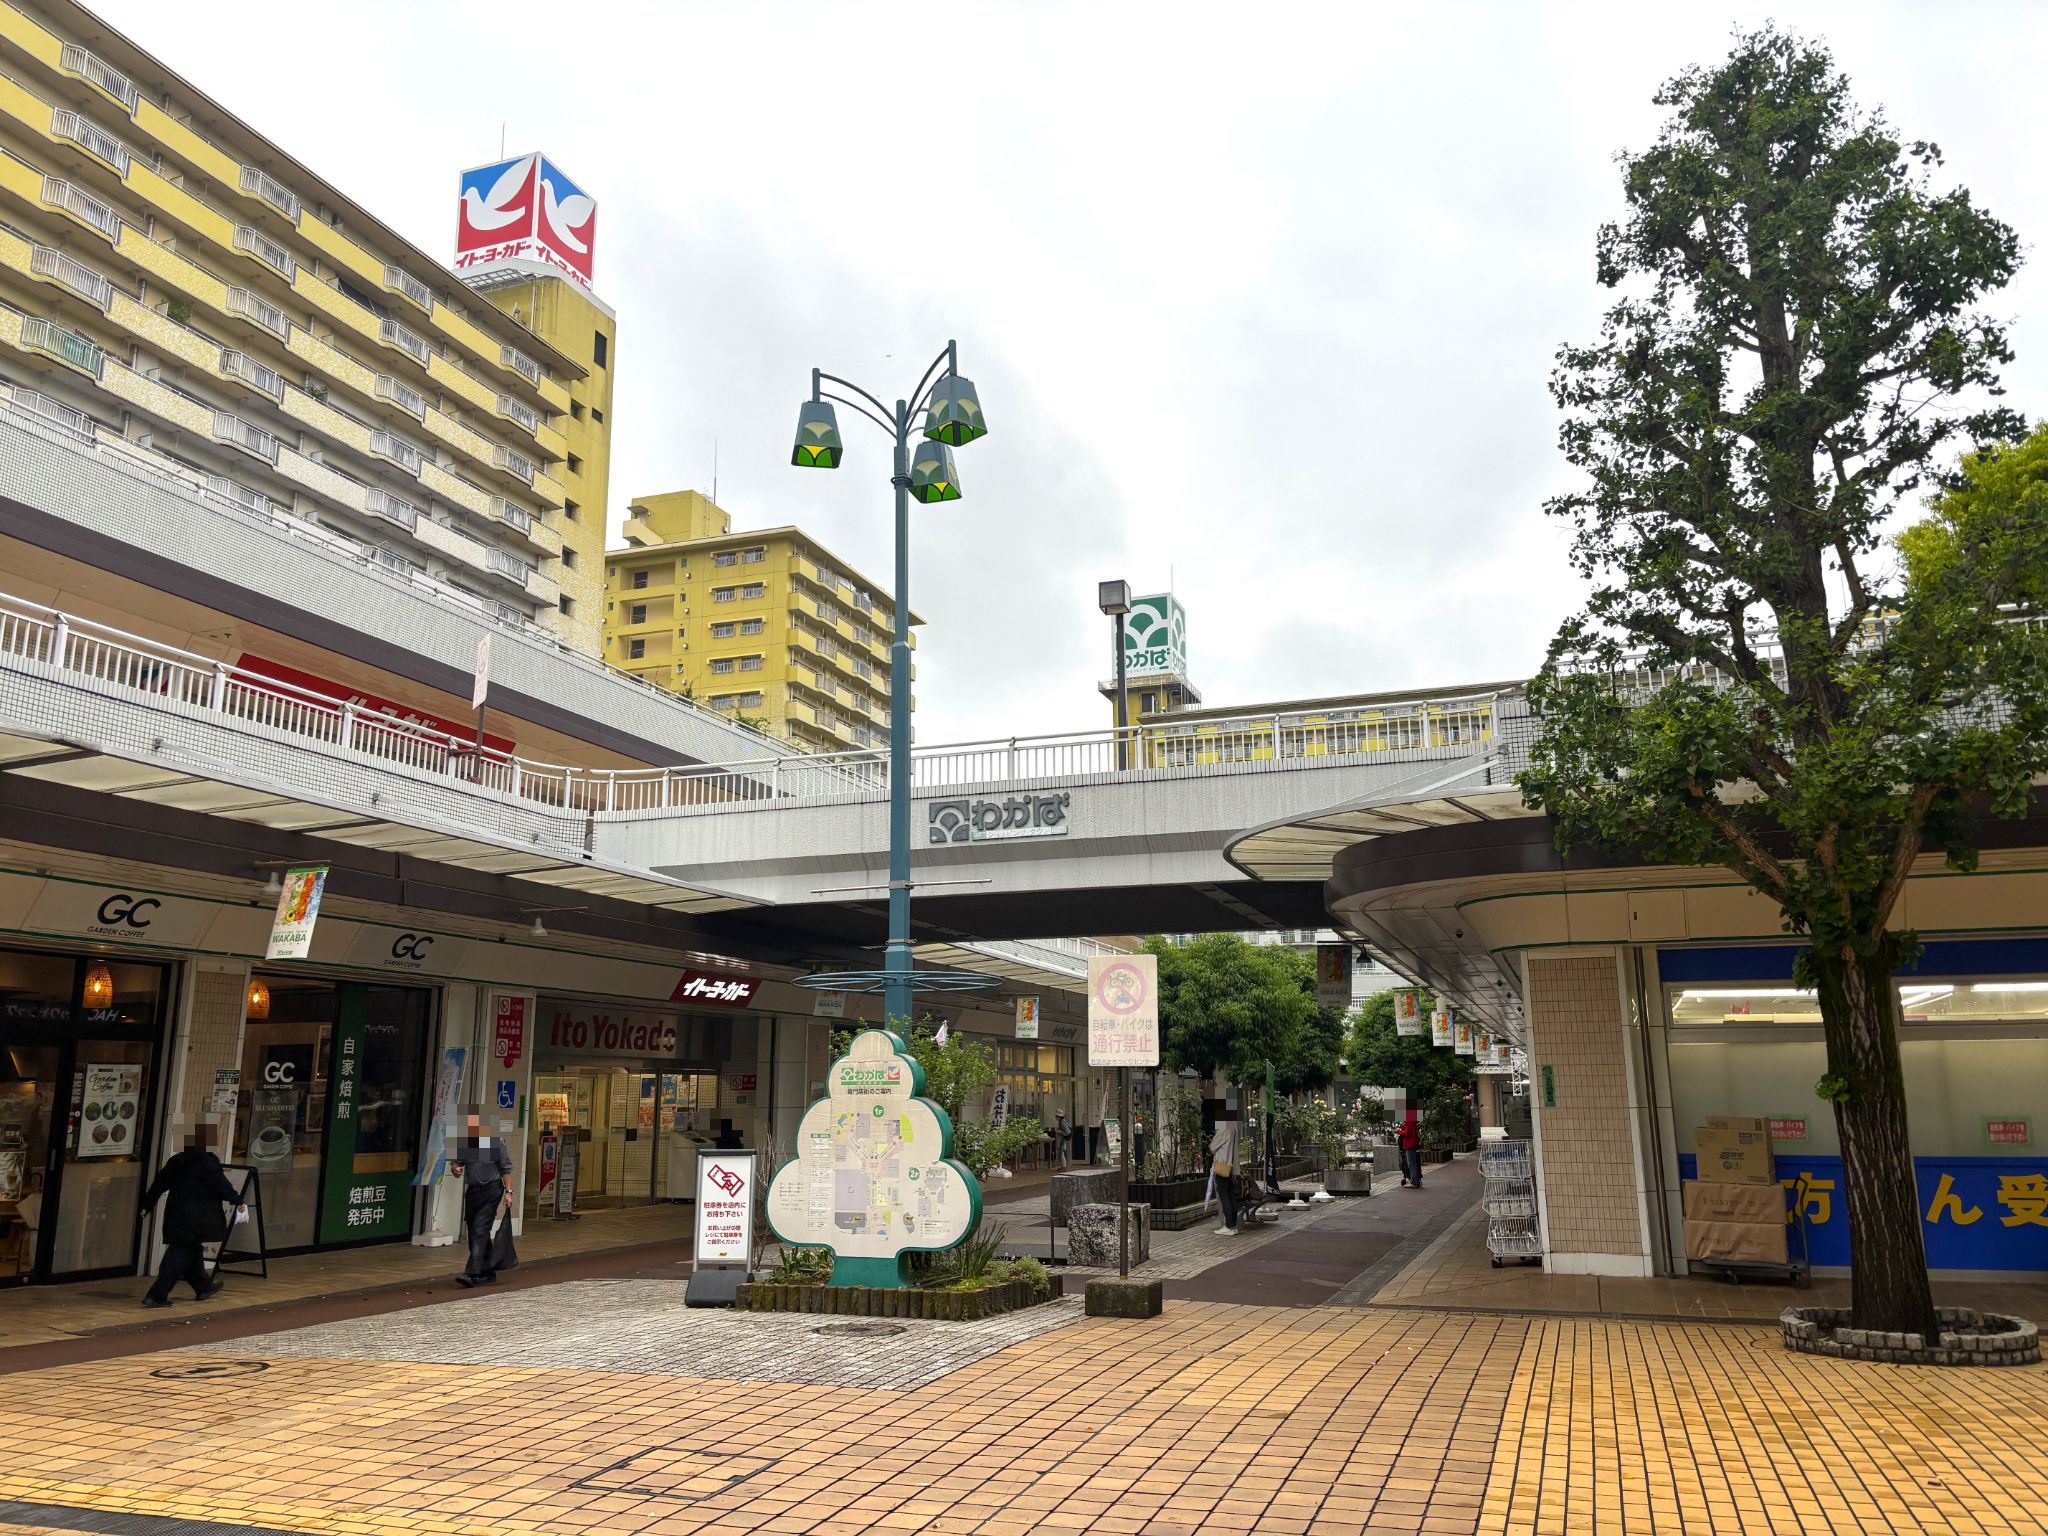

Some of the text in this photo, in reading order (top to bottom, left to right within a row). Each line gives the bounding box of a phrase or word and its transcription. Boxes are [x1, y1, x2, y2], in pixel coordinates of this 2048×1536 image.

[456, 241, 532, 269] イトーヨーカドー
[536, 245, 592, 292] イトーヨーカドー
[972, 792, 1070, 830] わかば
[97, 894, 161, 928] GC
[87, 926, 145, 938] GARDEN COFFEE
[273, 934, 306, 943] WAKABA
[392, 933, 434, 960] GC
[683, 978, 750, 1001] イトーヨーカドー
[550, 1011, 677, 1053] Ito Yokado
[1093, 1033, 1152, 1053] 通行禁止
[264, 1061, 296, 1083] GC
[337, 1037, 356, 1119] 自家焙煎
[855, 1069, 887, 1080] わかば
[348, 1185, 388, 1204] 焙煎豆
[703, 1201, 747, 1209] 駐車券を店内に
[347, 1206, 385, 1227] 発売中
[706, 1210, 743, 1218] お持ち下さい
